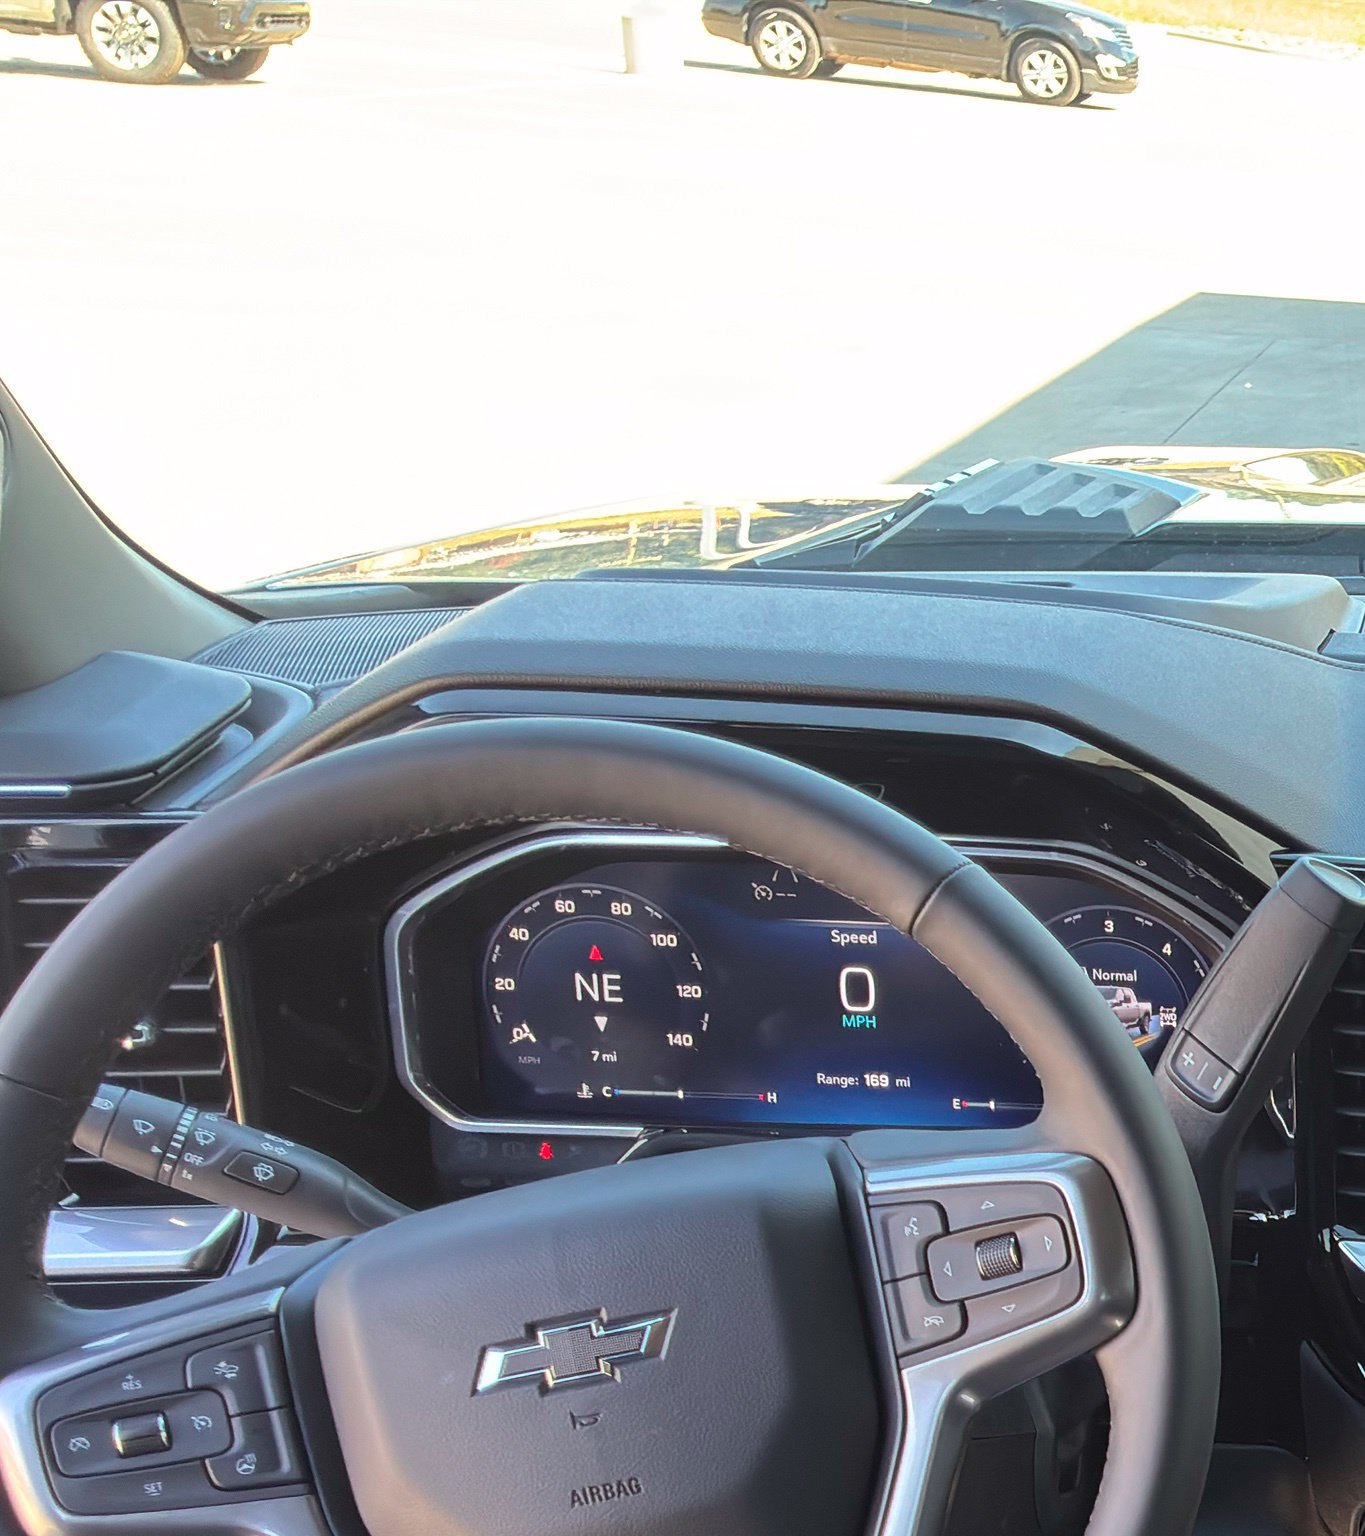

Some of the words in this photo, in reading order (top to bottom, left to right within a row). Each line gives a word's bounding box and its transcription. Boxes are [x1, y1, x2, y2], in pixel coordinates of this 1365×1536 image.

[555, 900, 576, 914] 60
[610, 902, 632, 916] 80
[1104, 919, 1114, 933] 3
[508, 927, 530, 942] 40
[650, 932, 678, 947] 100
[830, 929, 878, 946] Speed
[1161, 942, 1173, 957] 4
[1092, 968, 1138, 983] Normal
[494, 977, 516, 991] 20
[574, 972, 624, 1003] NE
[676, 984, 702, 998] 120
[839, 966, 876, 1012] 0
[842, 1013, 877, 1029] MPH
[666, 1033, 693, 1047] 140
[518, 1055, 542, 1066] MPH
[591, 1050, 600, 1062] 7
[602, 1050, 618, 1062] mi
[816, 1073, 860, 1089] Range:
[863, 1073, 890, 1088] 169
[895, 1075, 911, 1088] mi
[601, 1086, 612, 1098] C
[766, 1092, 778, 1104] H
[952, 1098, 962, 1110] E
[183, 1152, 204, 1166] OFF
[121, 1379, 142, 1391] RES
[143, 1481, 163, 1494] SET
[570, 1476, 642, 1509] AIRBAG
